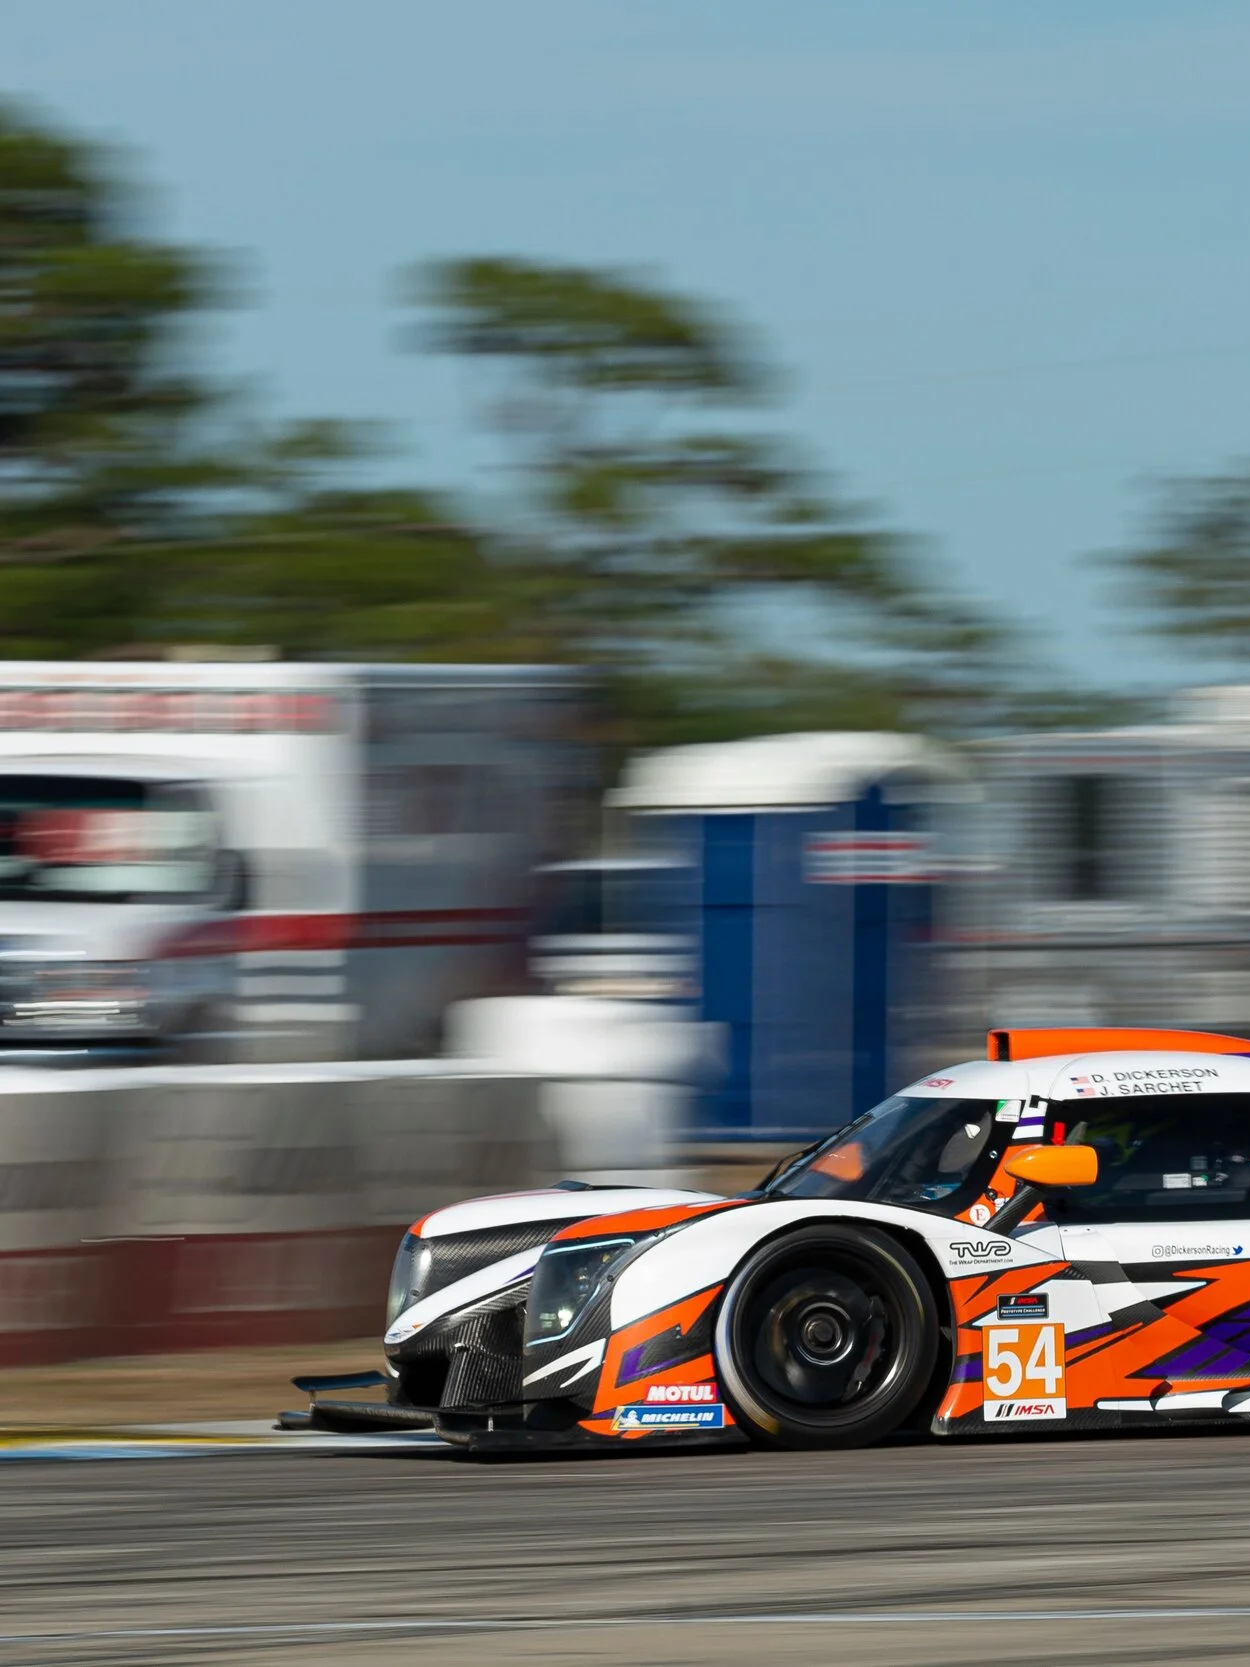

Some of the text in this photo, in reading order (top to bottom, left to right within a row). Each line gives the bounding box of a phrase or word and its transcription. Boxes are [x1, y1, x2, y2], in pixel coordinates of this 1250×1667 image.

[1091, 1068, 1220, 1084] D. DICKERSON
[1099, 1081, 1204, 1097] J. SARCHET
[1165, 1245, 1231, 1257] @DickersonRacing
[986, 1325, 1063, 1397] 54
[646, 1385, 714, 1402] MOTUL
[641, 1412, 715, 1423] MICHELIN
[1015, 1404, 1055, 1416] IMSA
